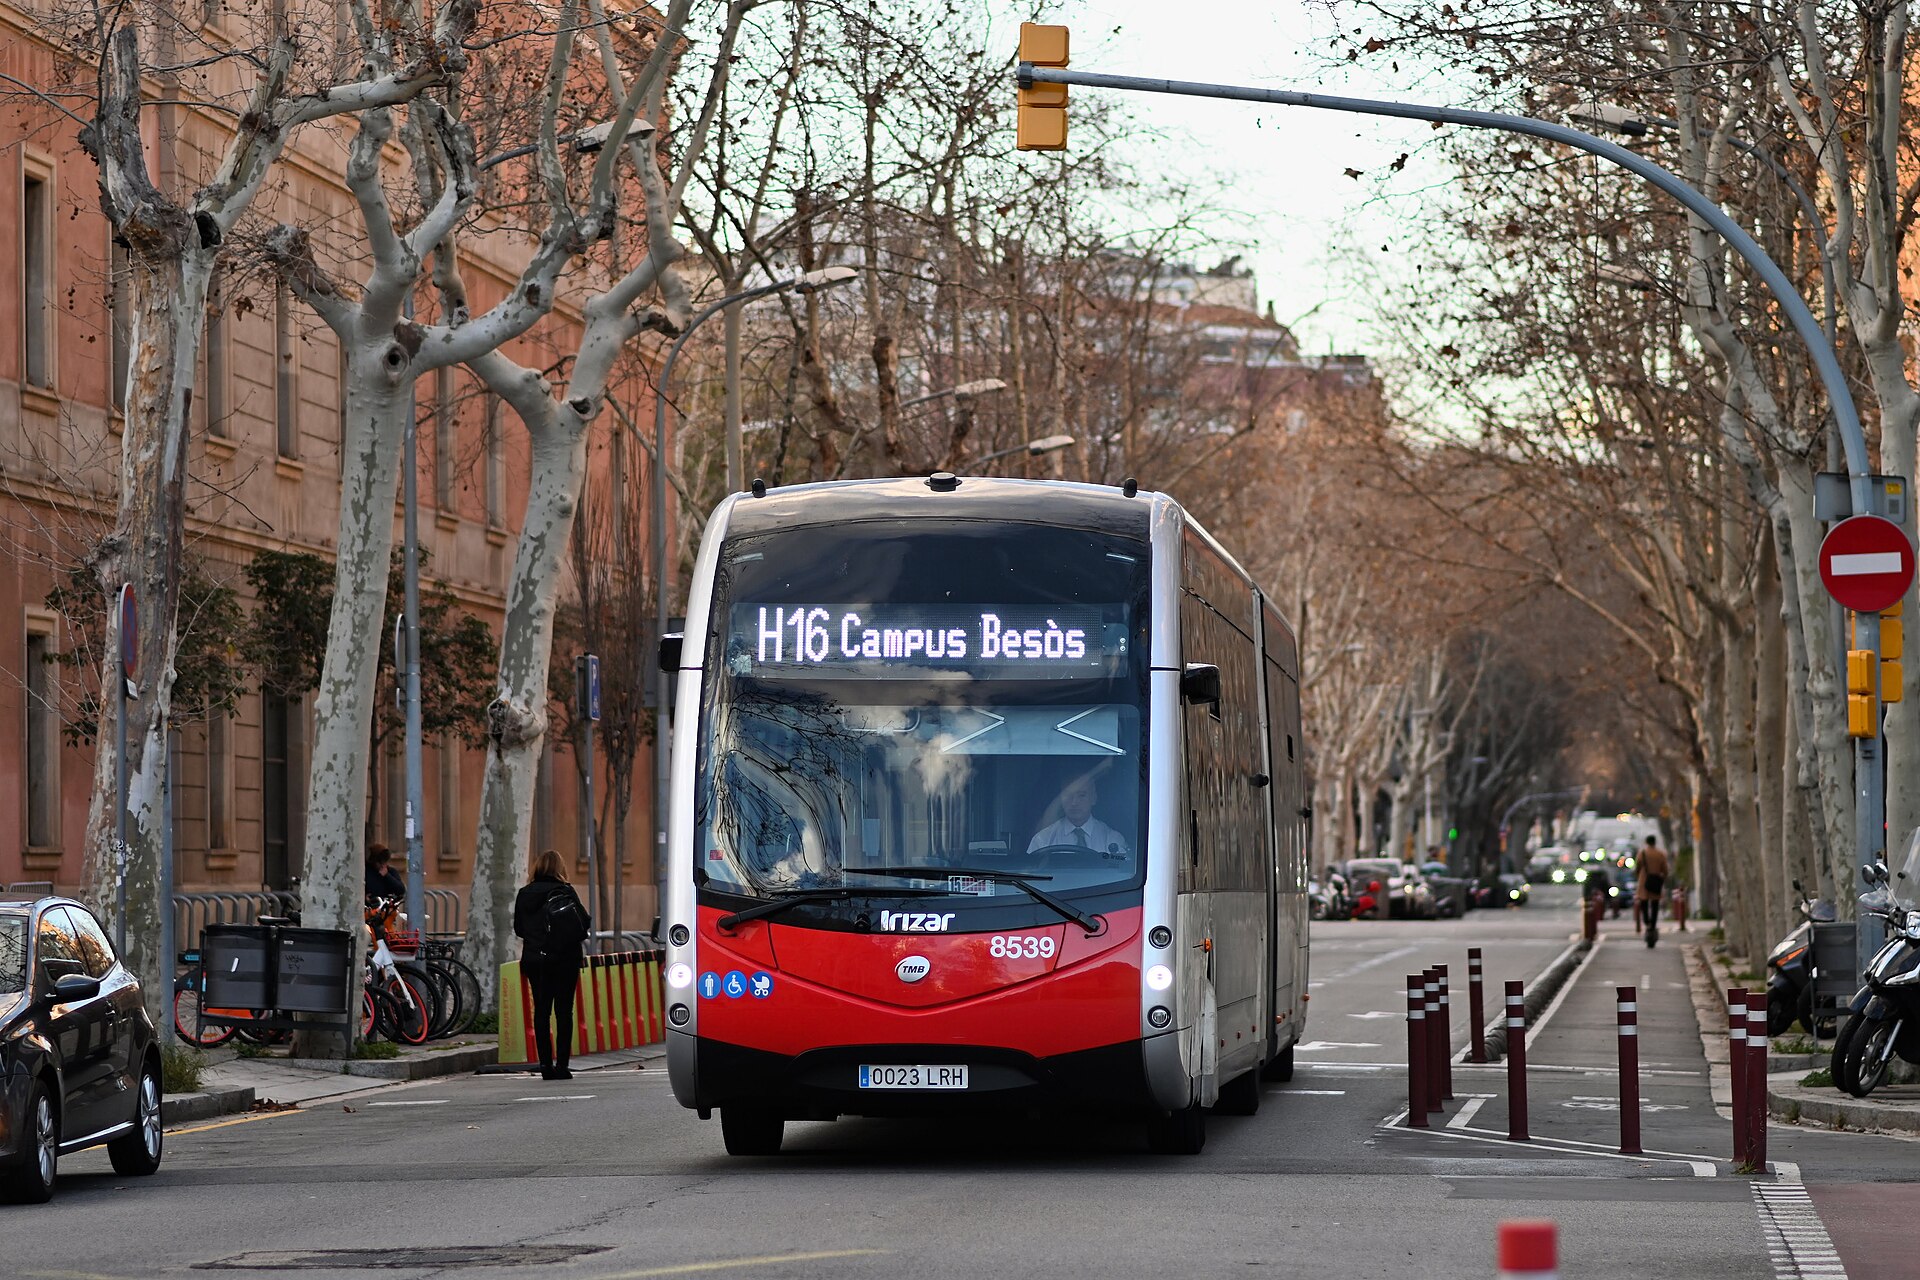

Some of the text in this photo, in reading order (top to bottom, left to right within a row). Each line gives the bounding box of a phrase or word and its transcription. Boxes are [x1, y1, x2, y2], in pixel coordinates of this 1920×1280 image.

[758, 607, 1085, 662] H16 Campus Besòs
[990, 936, 1055, 958] 8539
[902, 965, 925, 974] TMB
[872, 1068, 963, 1086] 0023 LRH
